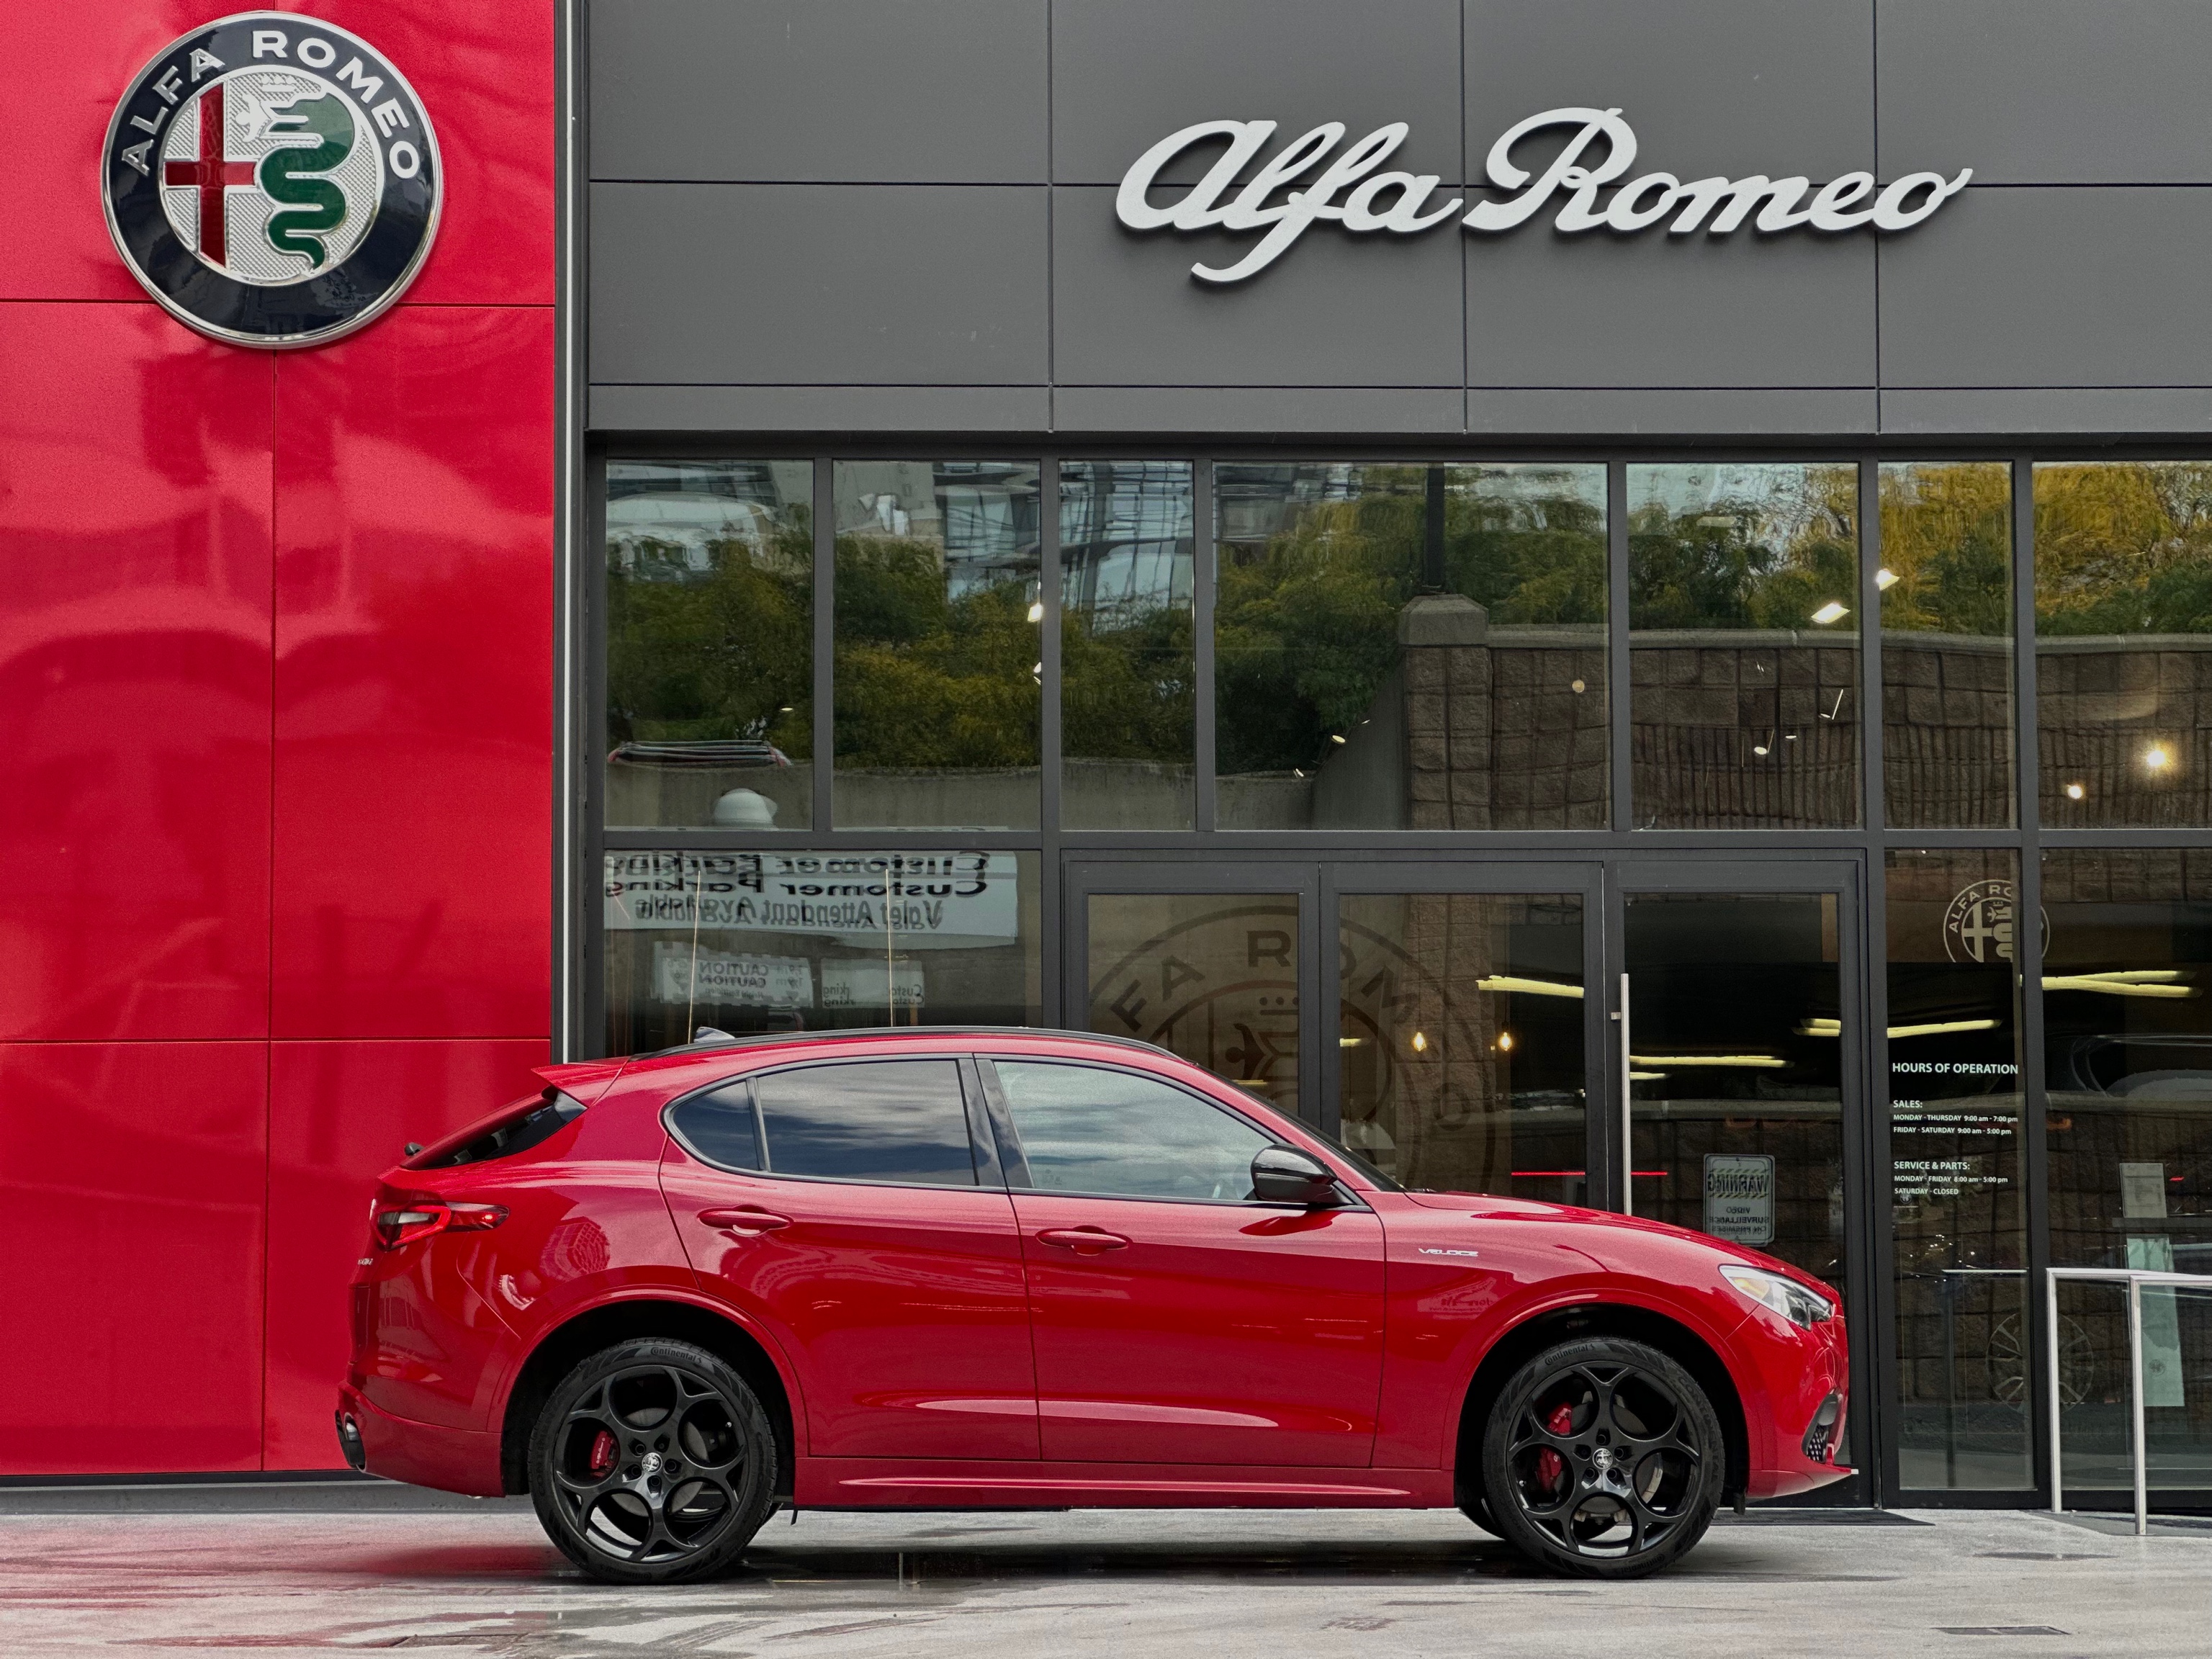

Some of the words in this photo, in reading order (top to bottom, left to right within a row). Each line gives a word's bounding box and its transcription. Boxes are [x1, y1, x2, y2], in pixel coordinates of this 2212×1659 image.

[122, 48, 225, 176] ALFA
[252, 30, 420, 179] ROMEO
[1115, 120, 1462, 283] Alfa
[1462, 107, 1973, 233] Romeo
[1948, 891, 1981, 934] ALFA
[1110, 955, 1205, 1033] FA
[1892, 1062, 1932, 1073] HOURS
[1935, 1063, 1950, 1073] OF
[1953, 1064, 2018, 1074] OPERATION
[1893, 1100, 1923, 1108] SALES:
[1894, 1161, 1930, 1169] SERVICE
[1940, 1161, 1970, 1170] PARTS:
[1418, 1247, 1478, 1257] VELOCE
[650, 1346, 696, 1362] Continental
[1545, 1344, 1589, 1366] Continental
